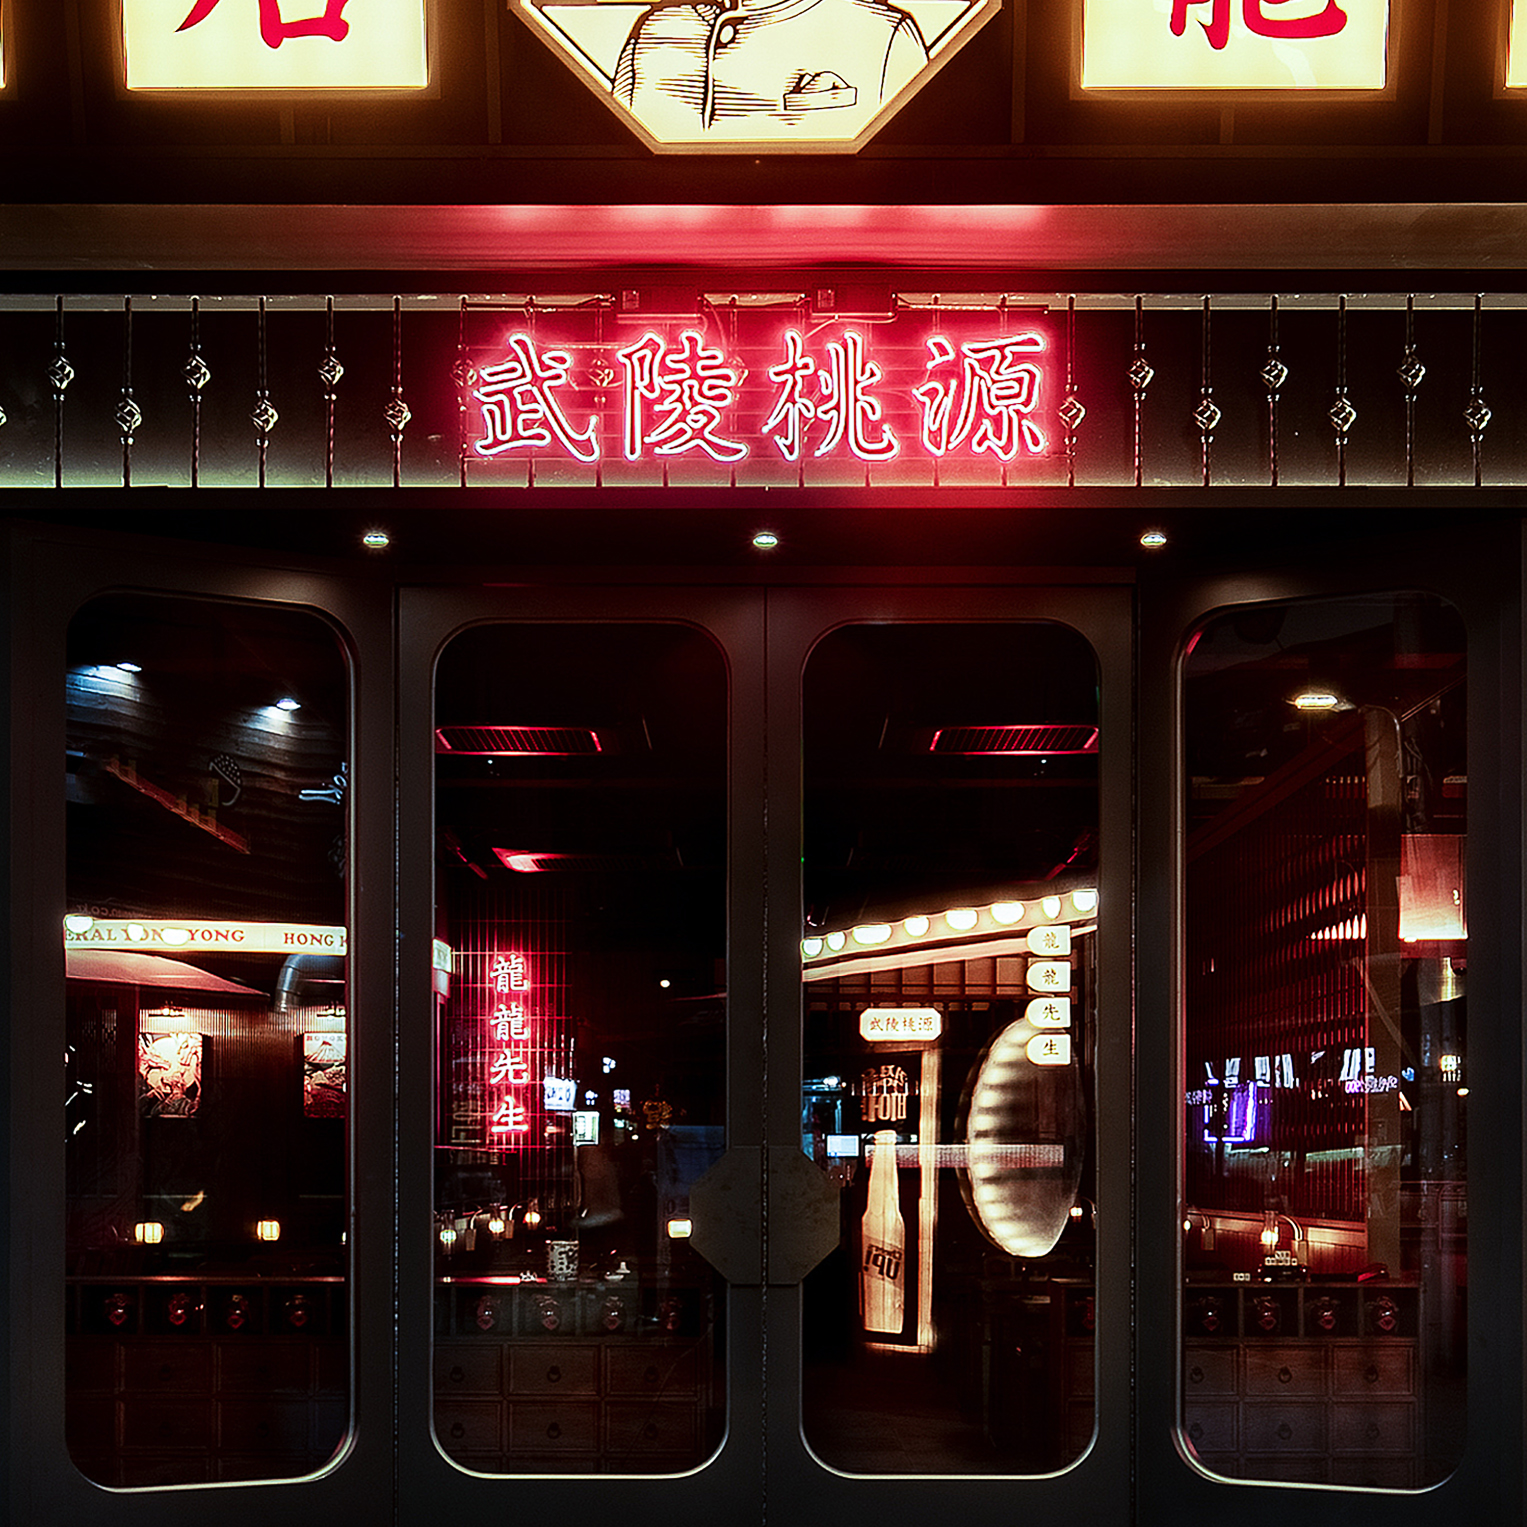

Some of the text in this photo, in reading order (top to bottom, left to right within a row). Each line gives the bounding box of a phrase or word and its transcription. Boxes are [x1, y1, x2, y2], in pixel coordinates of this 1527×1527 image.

[474, 330, 1049, 463] 武陵桃源
[187, 928, 246, 943] YONG
[283, 932, 335, 947] HONG
[490, 953, 531, 1134] 龍龍先生
[869, 1016, 934, 1032] 武陵桃源
